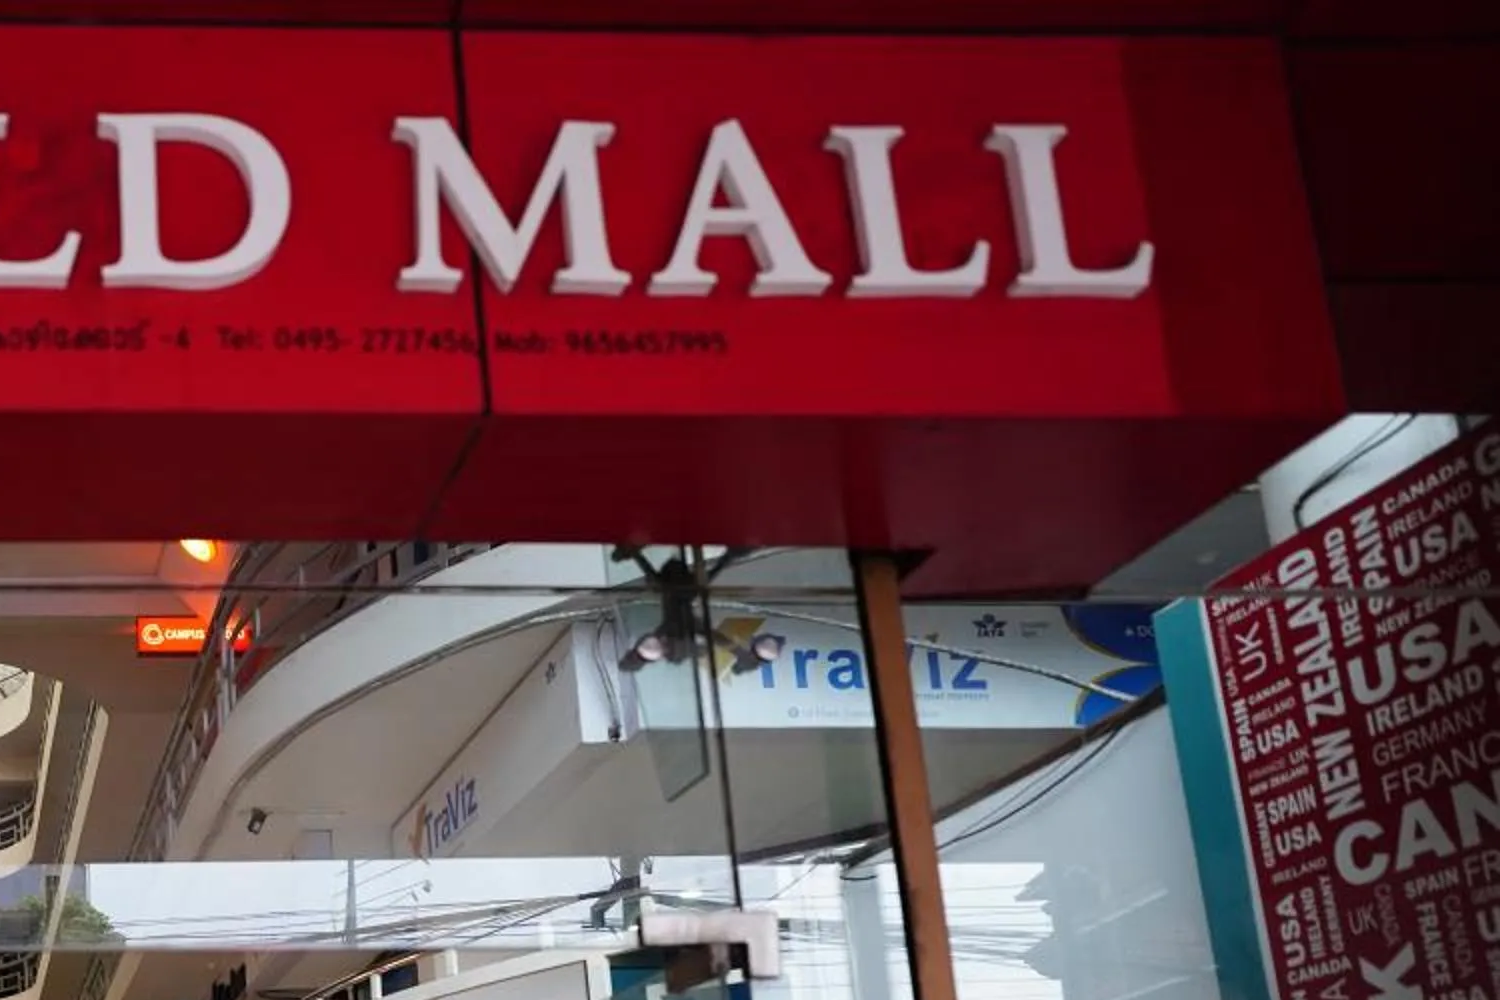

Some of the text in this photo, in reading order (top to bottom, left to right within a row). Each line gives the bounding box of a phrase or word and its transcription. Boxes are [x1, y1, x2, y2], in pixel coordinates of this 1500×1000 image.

[391, 116, 1154, 298] MALL
[1381, 456, 1470, 516] CANADA
[1349, 504, 1394, 618] SPAIN
[1393, 509, 1480, 578] USA
[1234, 620, 1268, 683] UK
[1277, 546, 1366, 822] NEW ZEALAND
[1348, 597, 1500, 705] USA
[1366, 663, 1484, 737] IRELAND
[1372, 697, 1488, 767] GERMANY
[1255, 719, 1302, 756] USA
[1266, 784, 1318, 826] SPAIN
[1274, 821, 1323, 857] USA
[1404, 866, 1460, 900] SPAIN
[1275, 893, 1307, 969] USA
[1347, 902, 1380, 937] UK
[1415, 901, 1453, 991] FRANCE
[1286, 954, 1353, 987] CANADA
